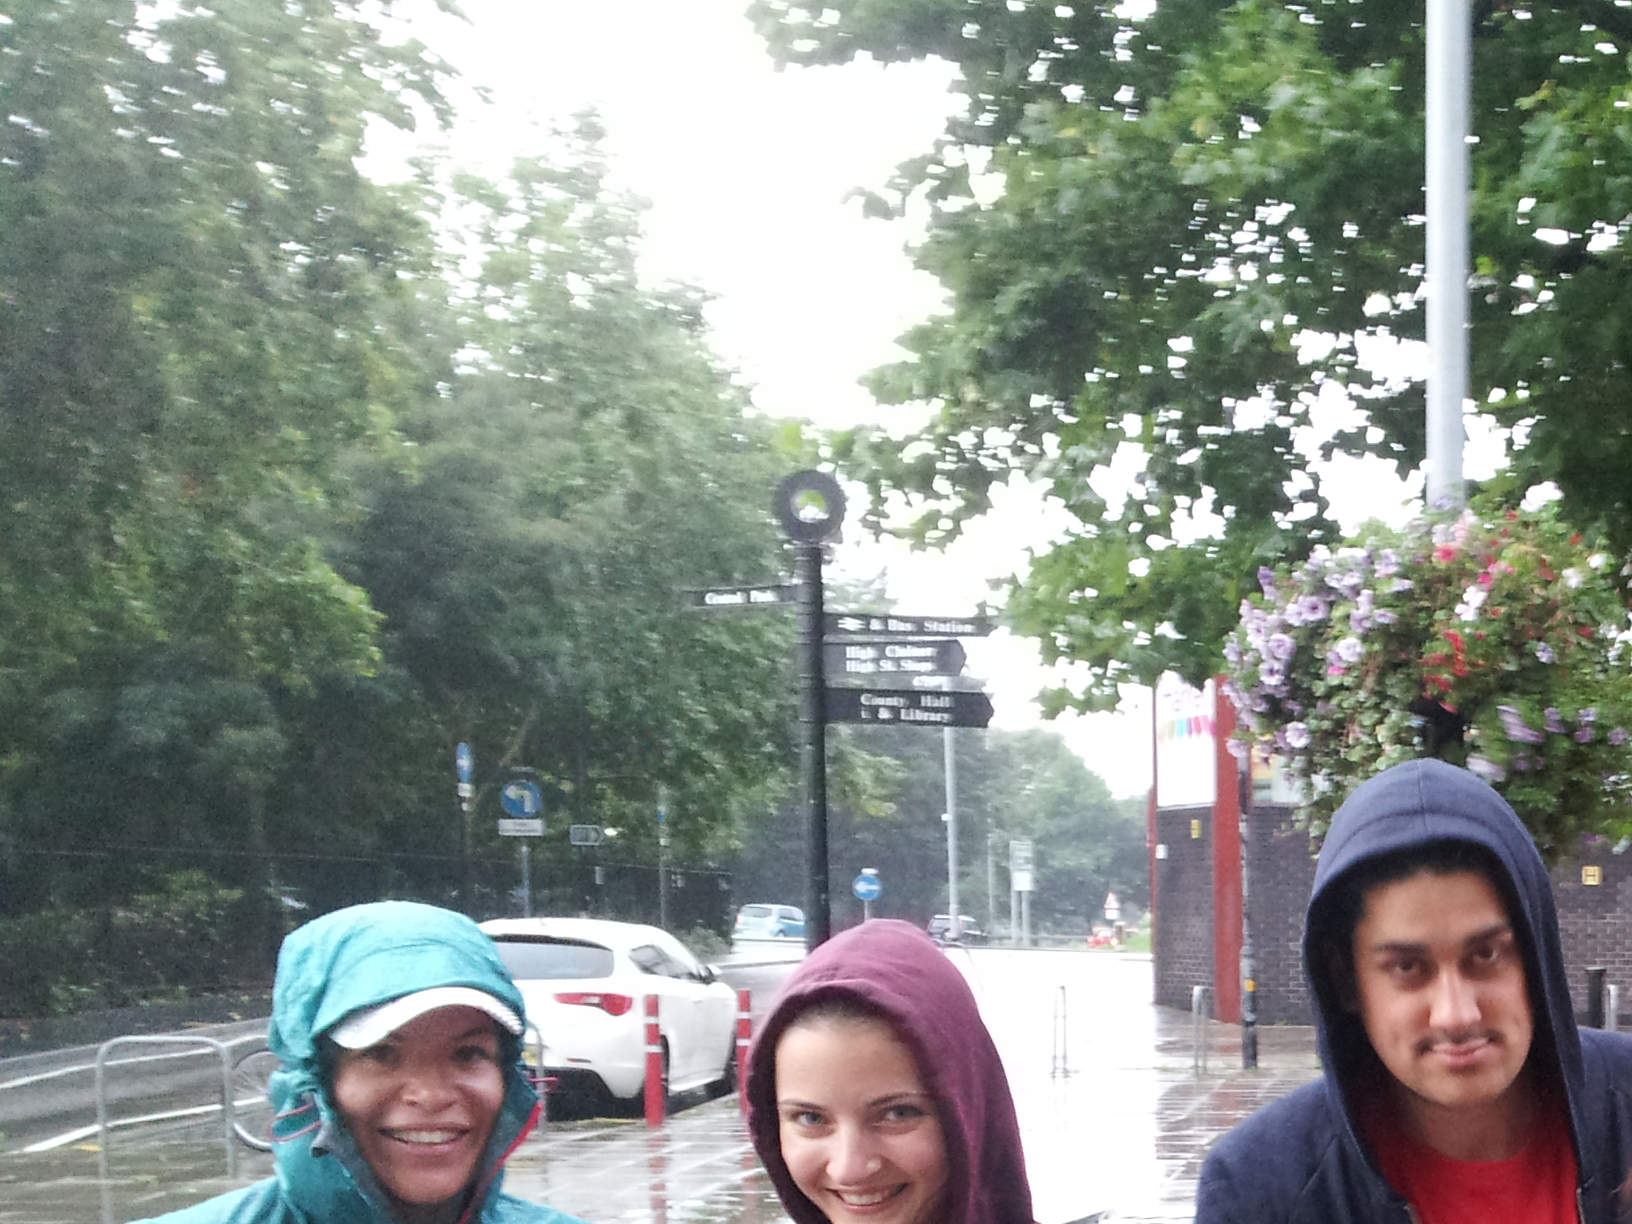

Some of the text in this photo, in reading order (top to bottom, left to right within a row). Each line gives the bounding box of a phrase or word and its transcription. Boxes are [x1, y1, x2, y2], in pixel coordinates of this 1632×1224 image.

[888, 619, 916, 632] Bus
[923, 620, 977, 633] Station
[860, 693, 954, 708] County Hall
[900, 708, 954, 723] Library
